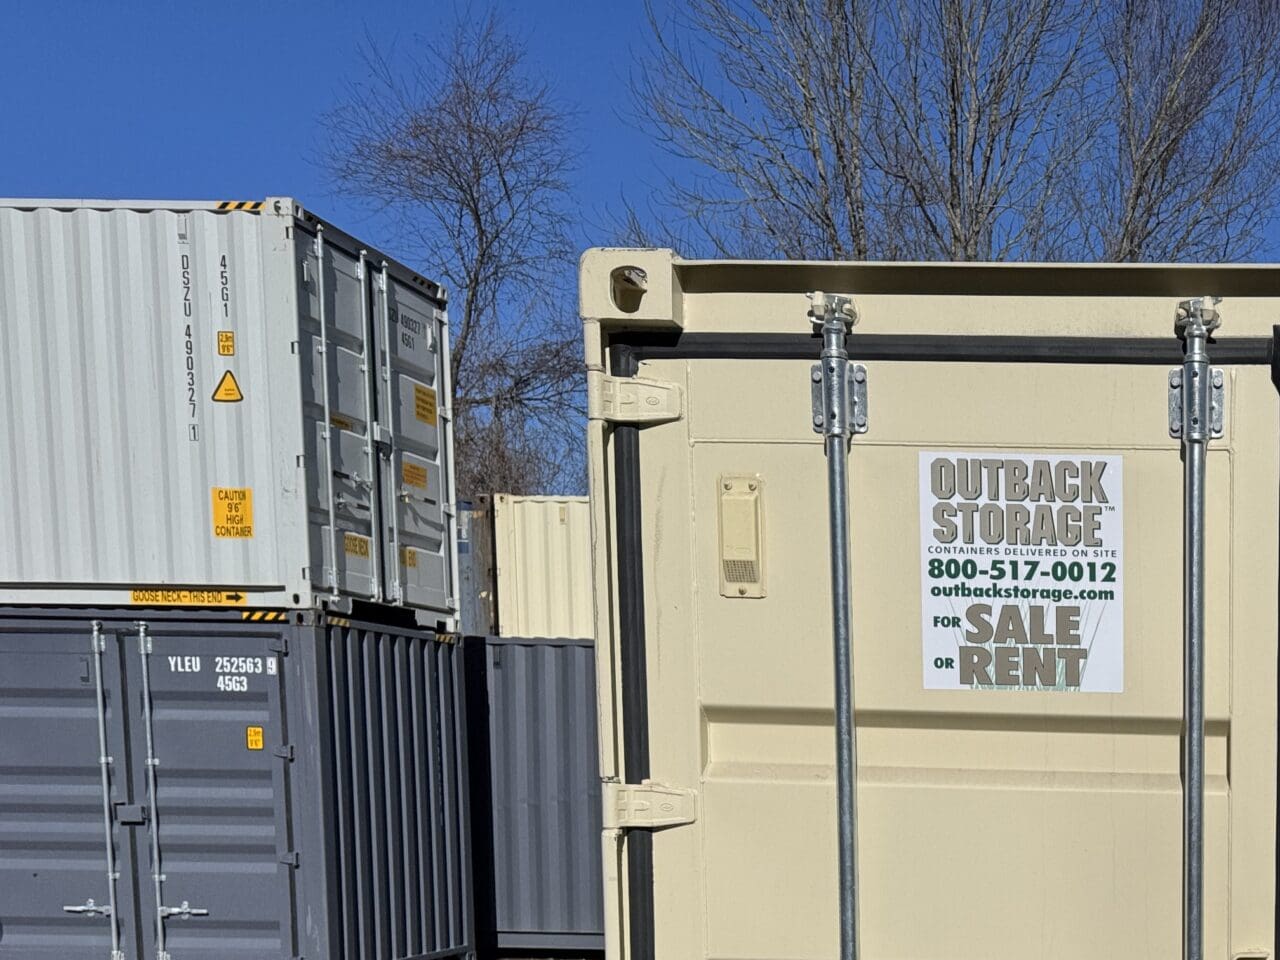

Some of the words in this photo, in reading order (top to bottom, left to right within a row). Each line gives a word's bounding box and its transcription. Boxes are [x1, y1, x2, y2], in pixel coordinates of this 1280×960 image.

[181, 254, 191, 317] DSZU
[220, 254, 229, 318] 45G1
[185, 324, 196, 418] 490327
[930, 457, 1109, 503] OUTBACK
[226, 514, 244, 525] HIGH
[932, 501, 1103, 547] STORAGE
[928, 545, 1000, 556] CONTAINERS
[1004, 547, 1067, 557] DELIVERED
[1072, 549, 1088, 557] ON
[1093, 549, 1117, 558] SITE
[928, 558, 1117, 582] 800-517-0012
[132, 590, 159, 602] GOOSE
[930, 582, 1115, 602] outbackstorage.com
[933, 616, 961, 628] FOR
[965, 603, 1081, 645] SALE
[168, 656, 201, 672] YLEU
[215, 656, 262, 673] 252563
[266, 656, 277, 675] 9
[934, 657, 954, 669] OR
[959, 646, 1087, 687] RENT
[217, 675, 248, 692] 45G3
